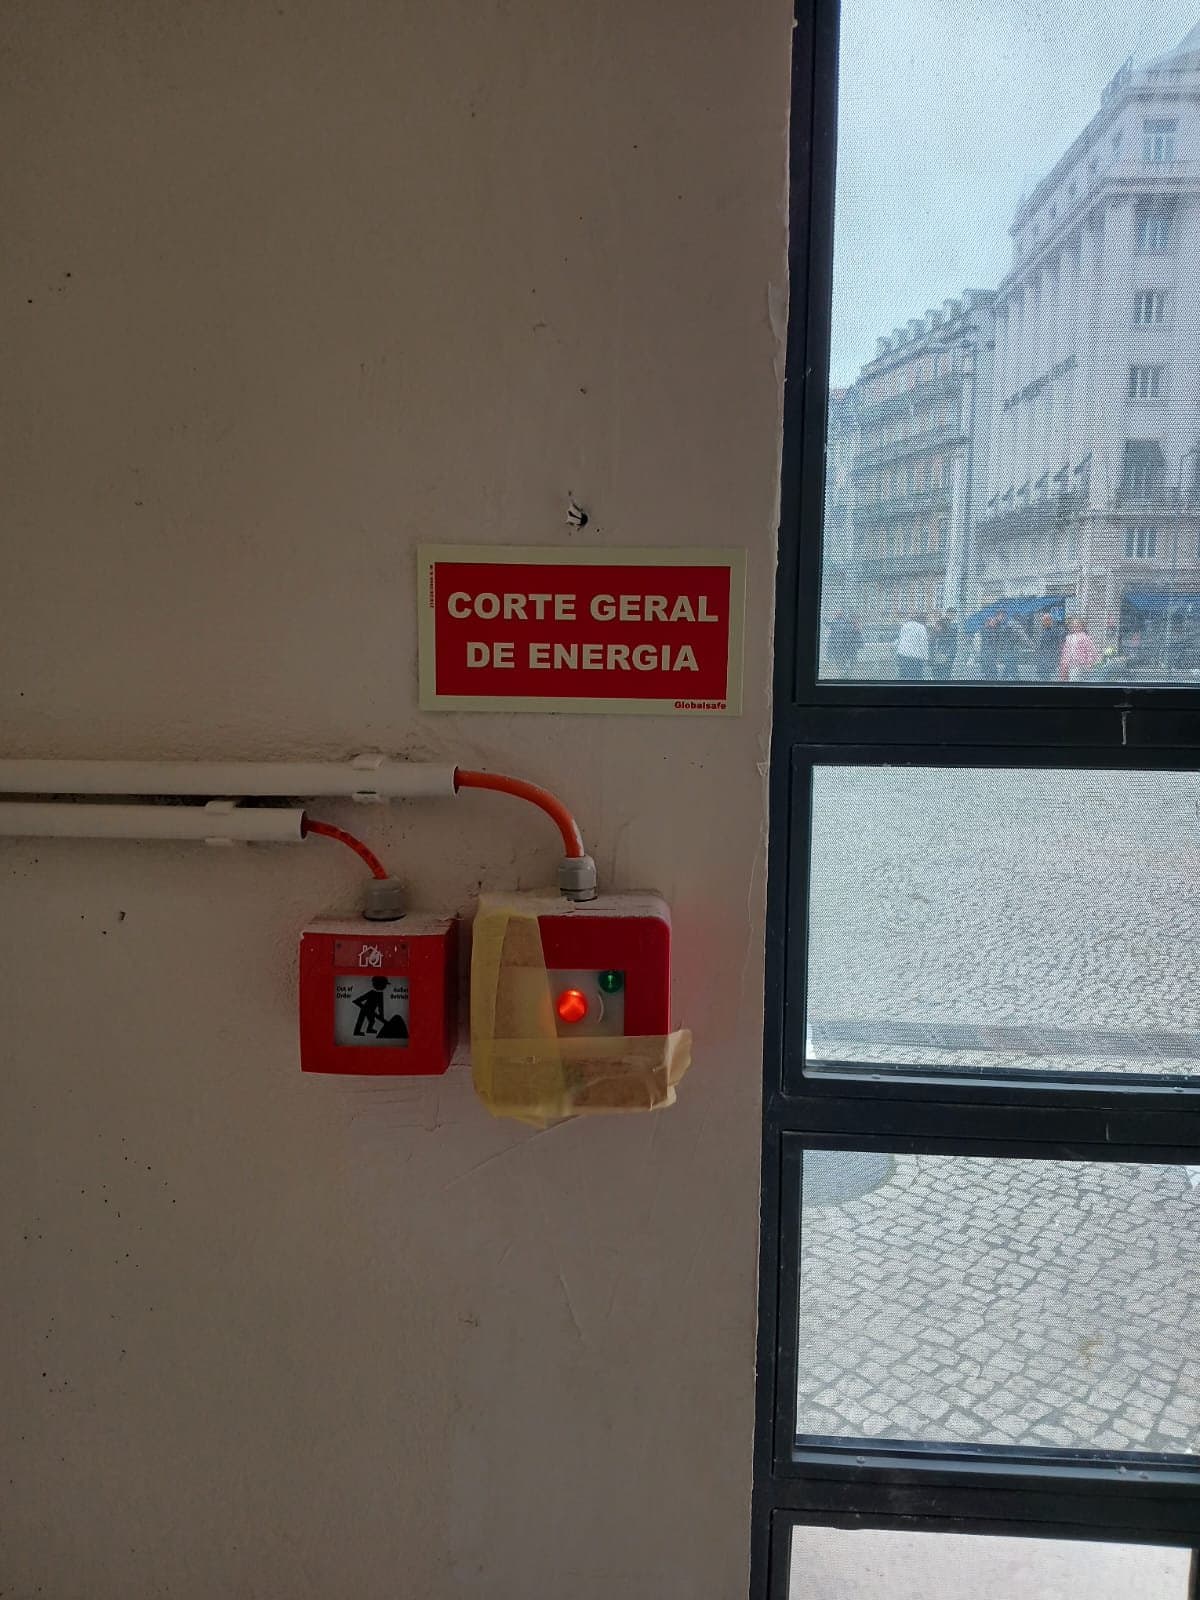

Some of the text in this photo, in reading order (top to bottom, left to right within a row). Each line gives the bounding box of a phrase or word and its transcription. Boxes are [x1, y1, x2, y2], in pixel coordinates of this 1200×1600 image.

[447, 591, 719, 622] CORTE GERAL
[466, 641, 699, 672] DE ENERGIA
[674, 701, 727, 709] Globalsafe
